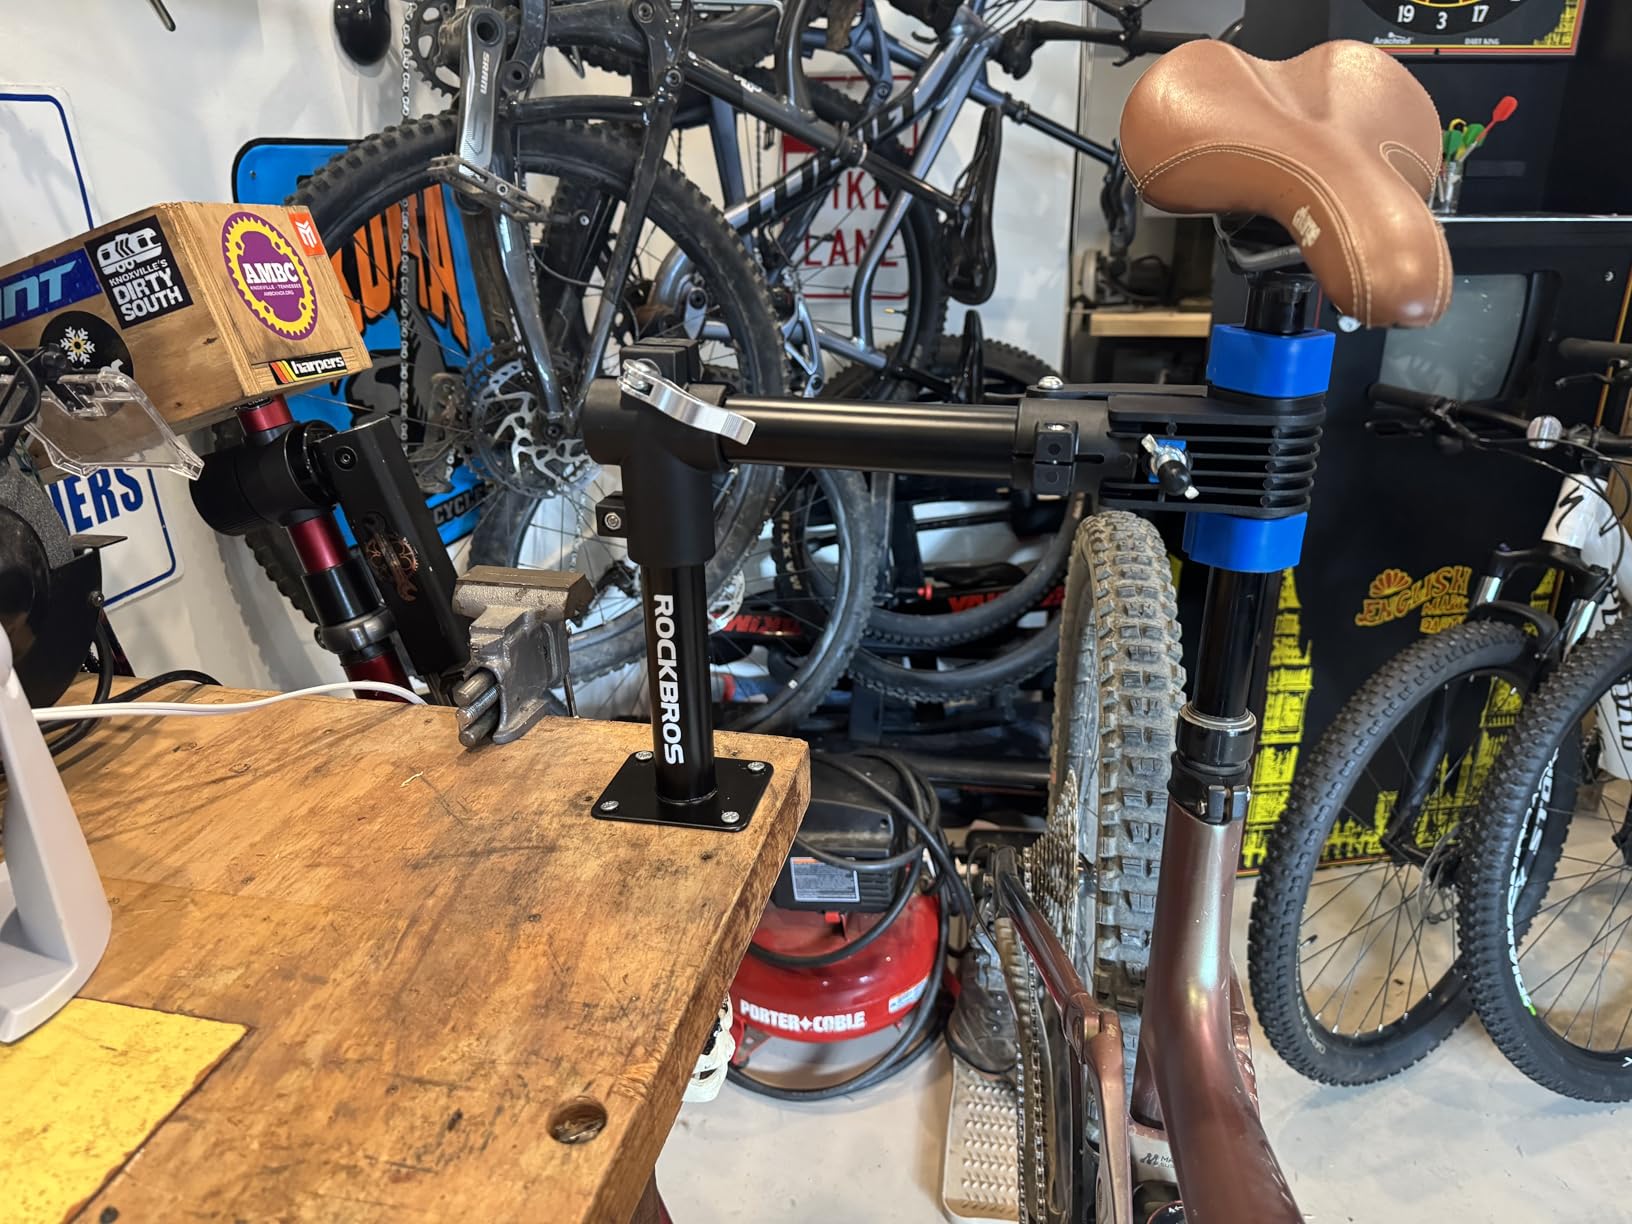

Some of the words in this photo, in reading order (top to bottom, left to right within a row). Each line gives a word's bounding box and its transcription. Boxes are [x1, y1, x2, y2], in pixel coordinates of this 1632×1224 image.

[1397, 5, 1415, 22] 19
[1436, 11, 1448, 30] 3
[1472, 5, 1489, 22] 17
[480, 51, 491, 95] SRAM
[109, 258, 168, 286] KNOXVILLE'S
[243, 262, 298, 284] AMBC
[112, 268, 174, 305] DIRTY
[120, 285, 184, 322] SOUTH
[291, 356, 345, 374] harpers
[1355, 565, 1473, 627] ENGLISH
[653, 594, 685, 765] ROCKBROS
